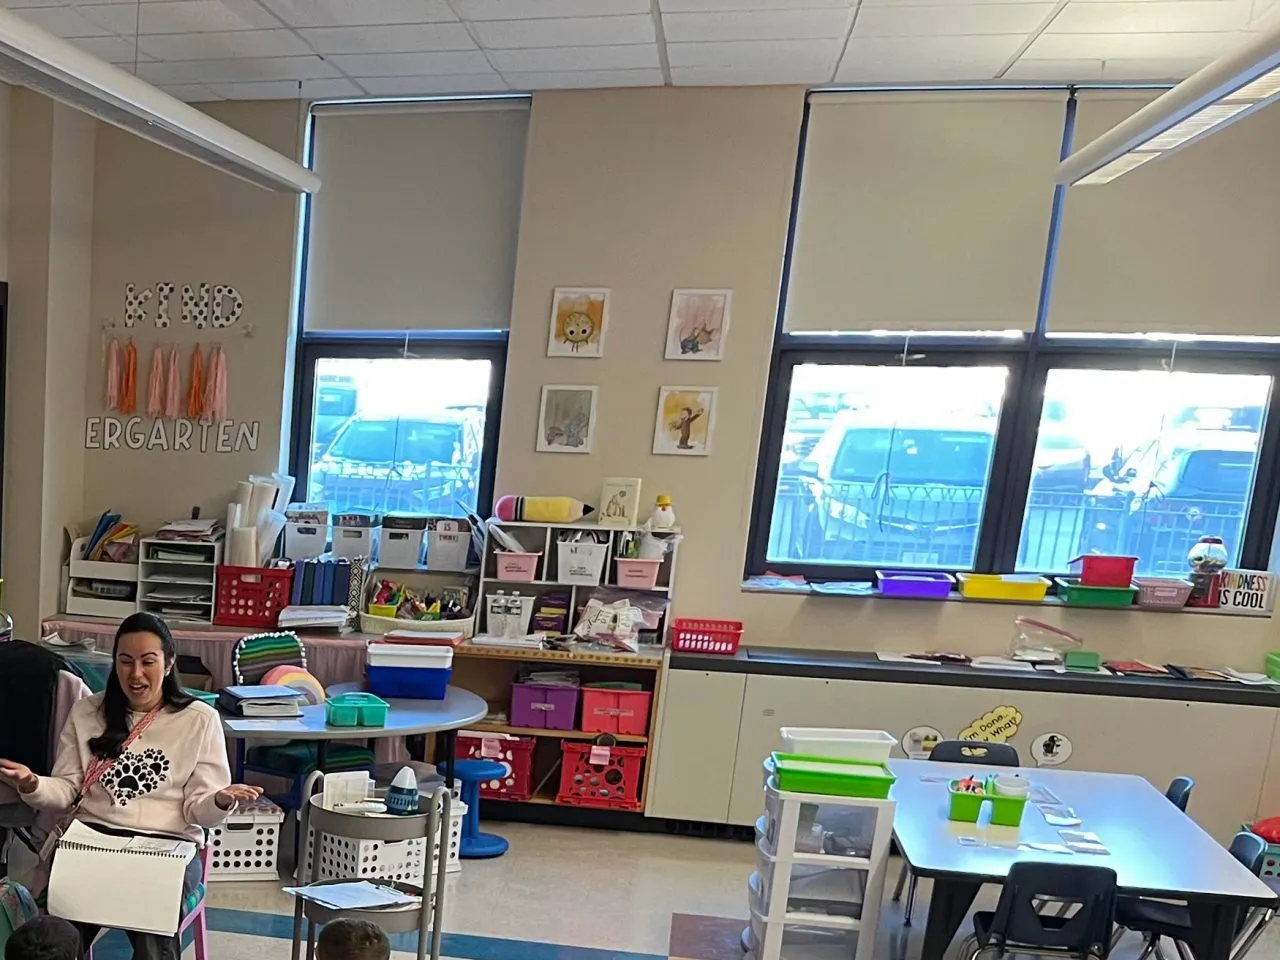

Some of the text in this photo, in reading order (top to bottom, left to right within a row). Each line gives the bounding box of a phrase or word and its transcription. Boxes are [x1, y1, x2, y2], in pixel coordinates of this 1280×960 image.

[124, 281, 245, 330] KIND
[85, 416, 261, 454] ERGARTEN
[1220, 571, 1268, 592] KINDNESS
[1233, 590, 1264, 608] COOL
